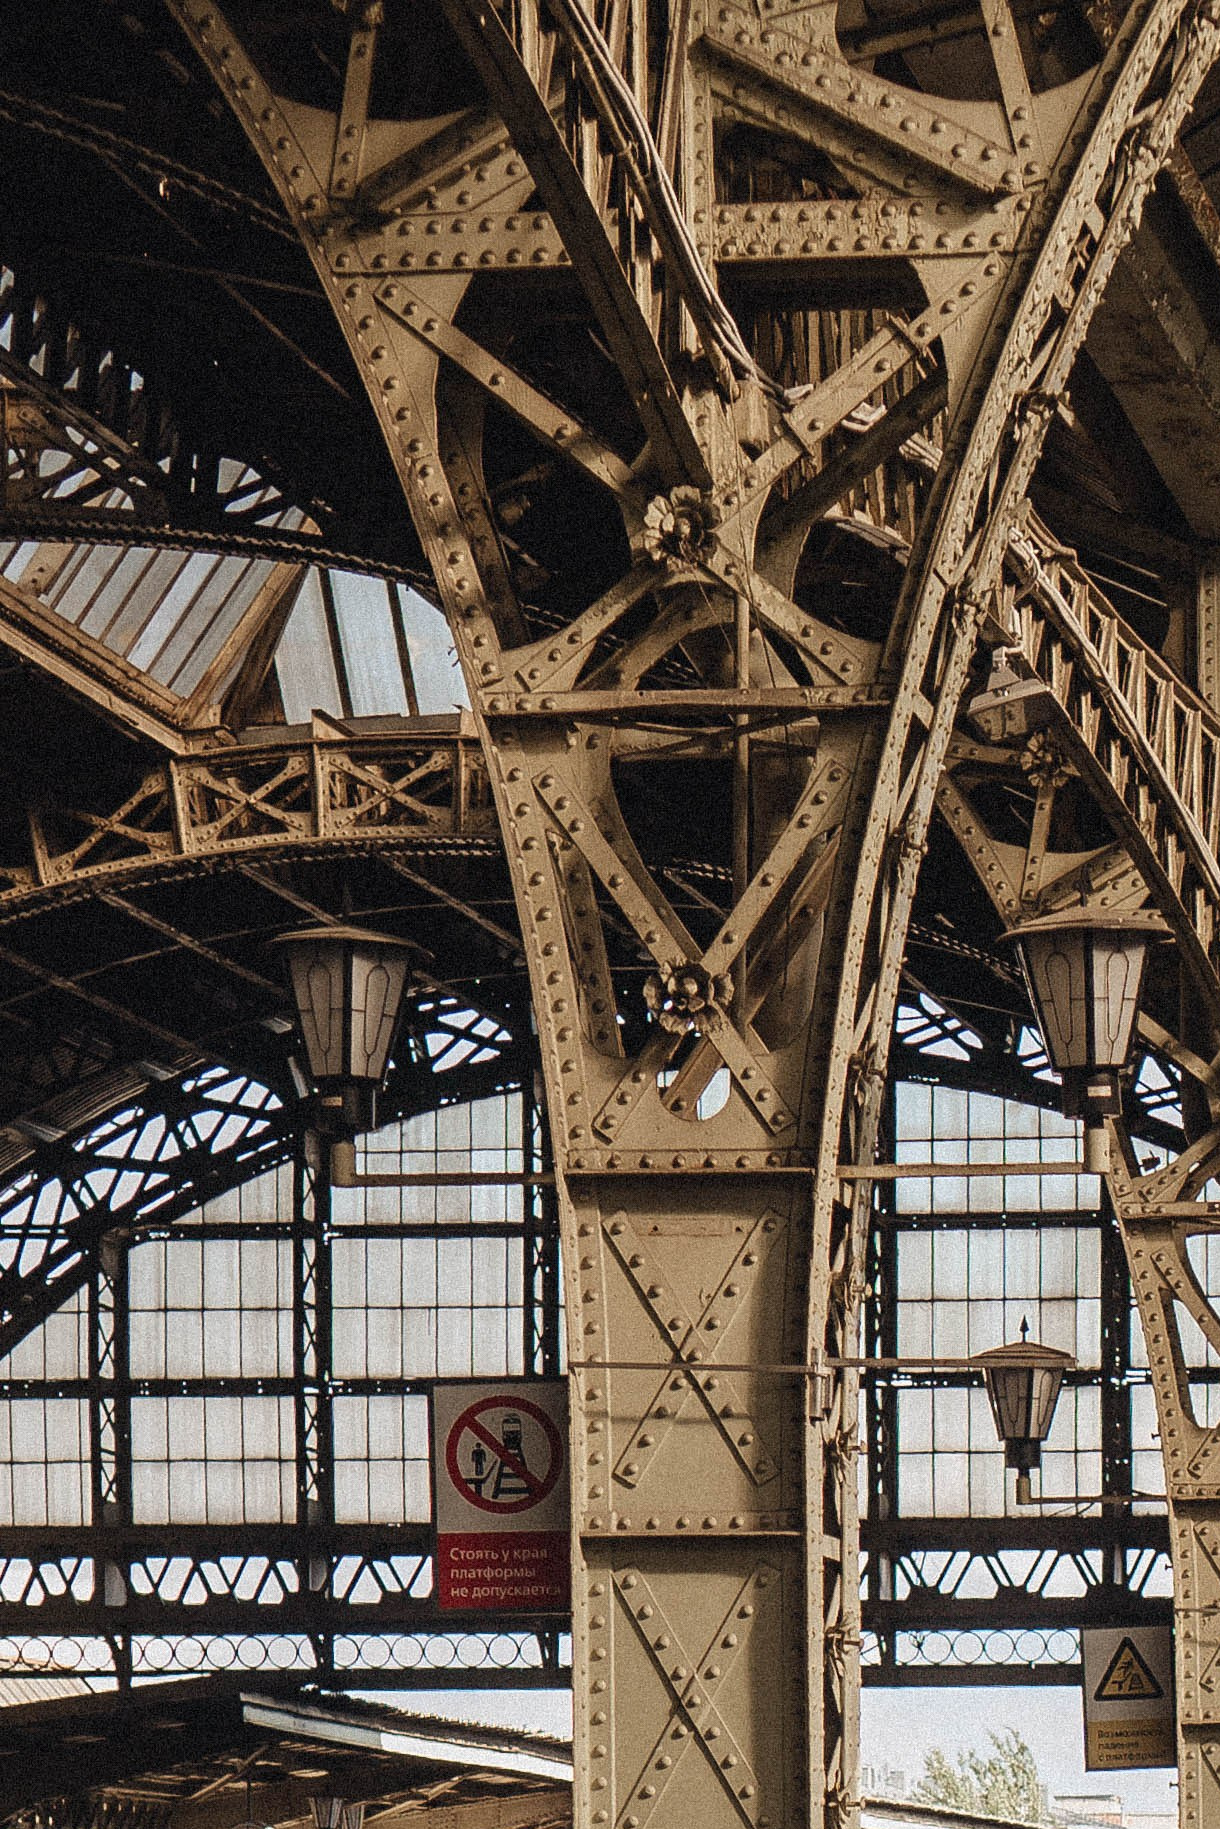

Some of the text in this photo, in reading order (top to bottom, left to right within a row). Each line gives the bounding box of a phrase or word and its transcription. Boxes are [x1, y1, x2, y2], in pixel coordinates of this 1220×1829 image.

[449, 1547, 548, 1563] Стоять у края
[450, 1566, 536, 1581] платформы
[450, 1585, 561, 1600] не допускается
